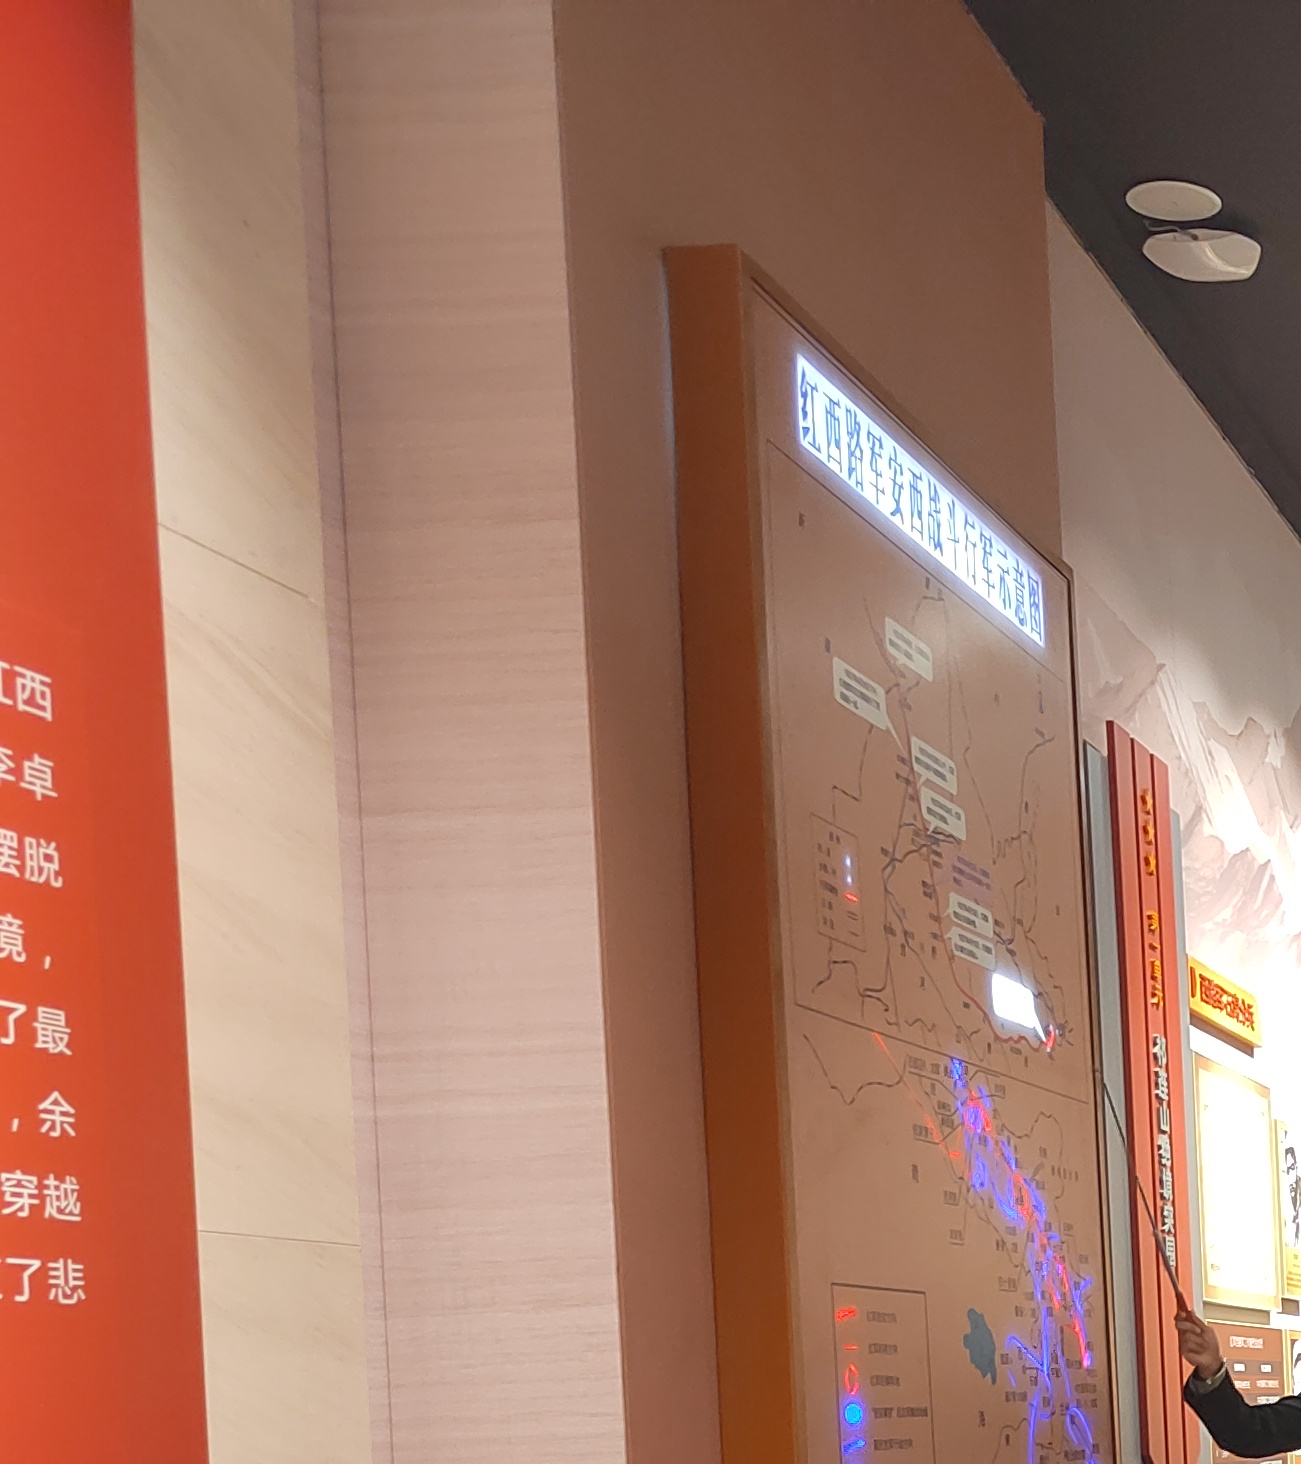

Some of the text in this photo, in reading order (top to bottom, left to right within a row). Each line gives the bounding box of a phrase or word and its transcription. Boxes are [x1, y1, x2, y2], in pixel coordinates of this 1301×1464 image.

[799, 366, 1042, 642] 红西路军安西战斗行军示意图
[0, 999, 72, 1055] 了最
[0, 1170, 82, 1221] 穿越
[0, 1257, 86, 1304] 了悲
